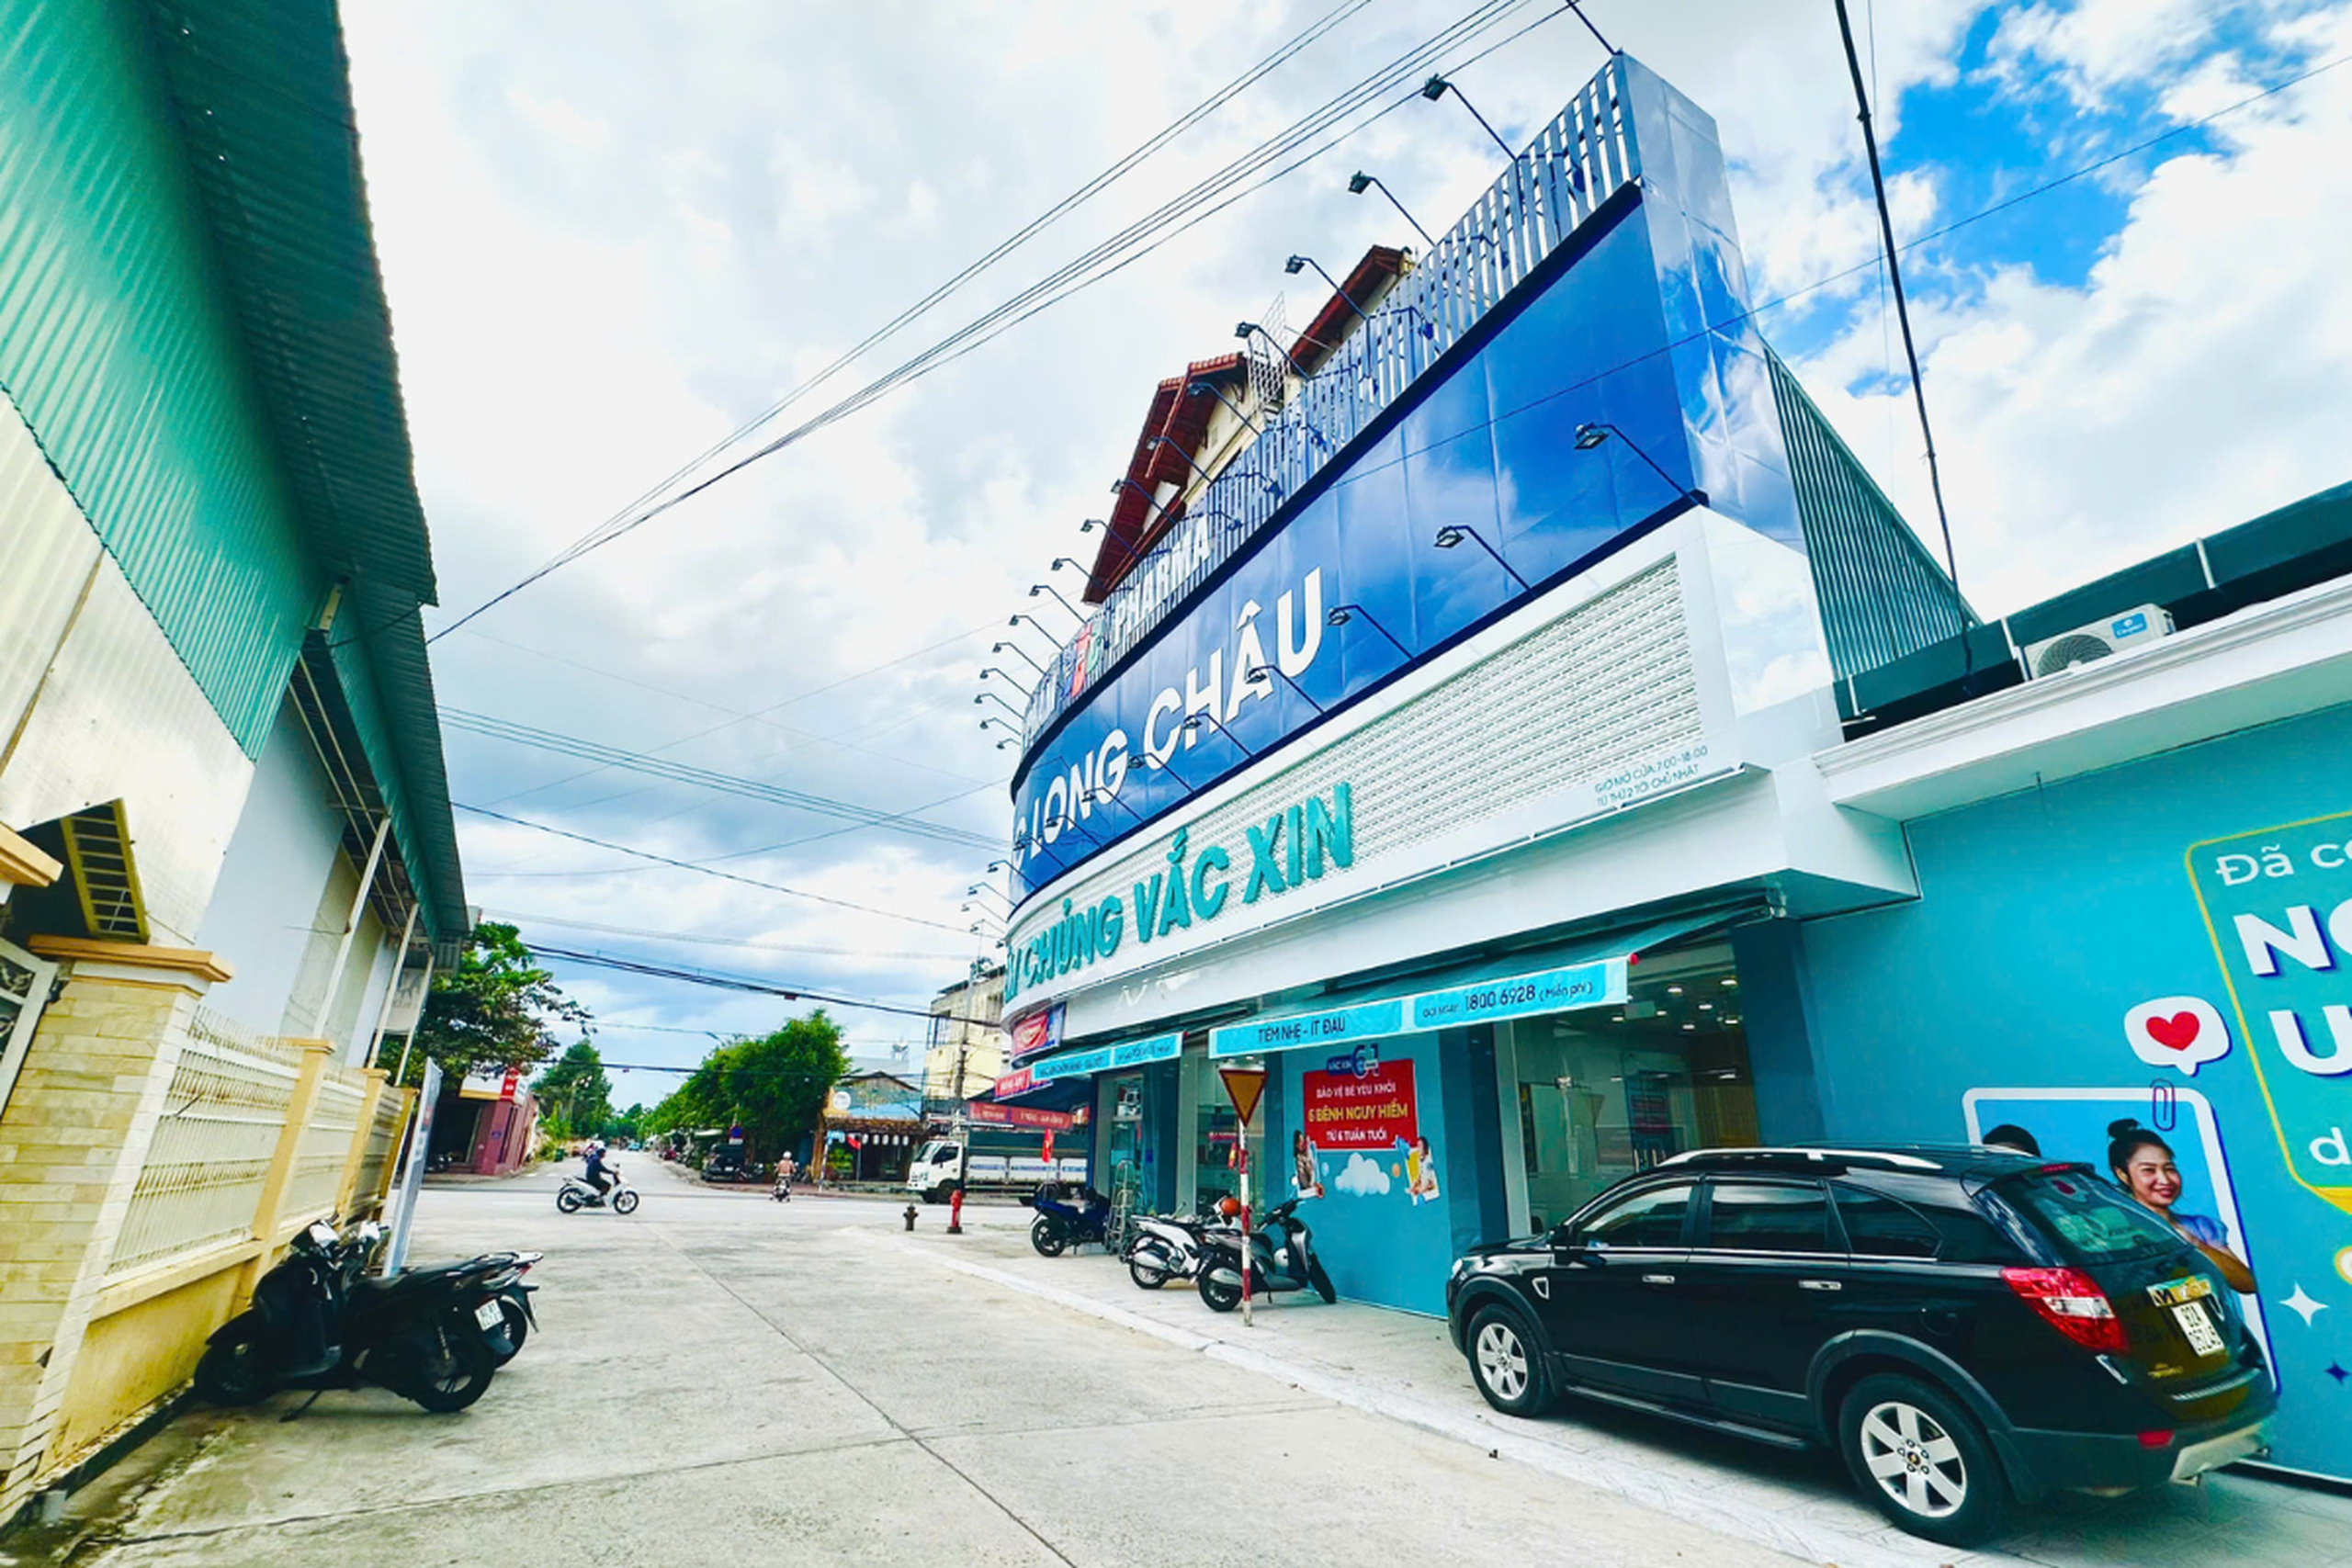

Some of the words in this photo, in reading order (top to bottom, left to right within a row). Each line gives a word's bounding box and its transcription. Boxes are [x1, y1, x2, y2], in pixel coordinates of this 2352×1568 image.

[1030, 728, 1128, 860] LONG
[1142, 566, 1323, 770] CHÂU
[2215, 843, 2294, 886] Đã
[2311, 840, 2352, 868] c
[1023, 895, 1124, 988] CHỦNG
[1134, 827, 1230, 943] VẮC
[1243, 781, 1353, 904] XIN
[1465, 990, 1497, 1011] 1800
[1499, 985, 1535, 1005] 6928
[1322, 1017, 1345, 1034] ĐAU
[1346, 1105, 1376, 1121] NGUY
